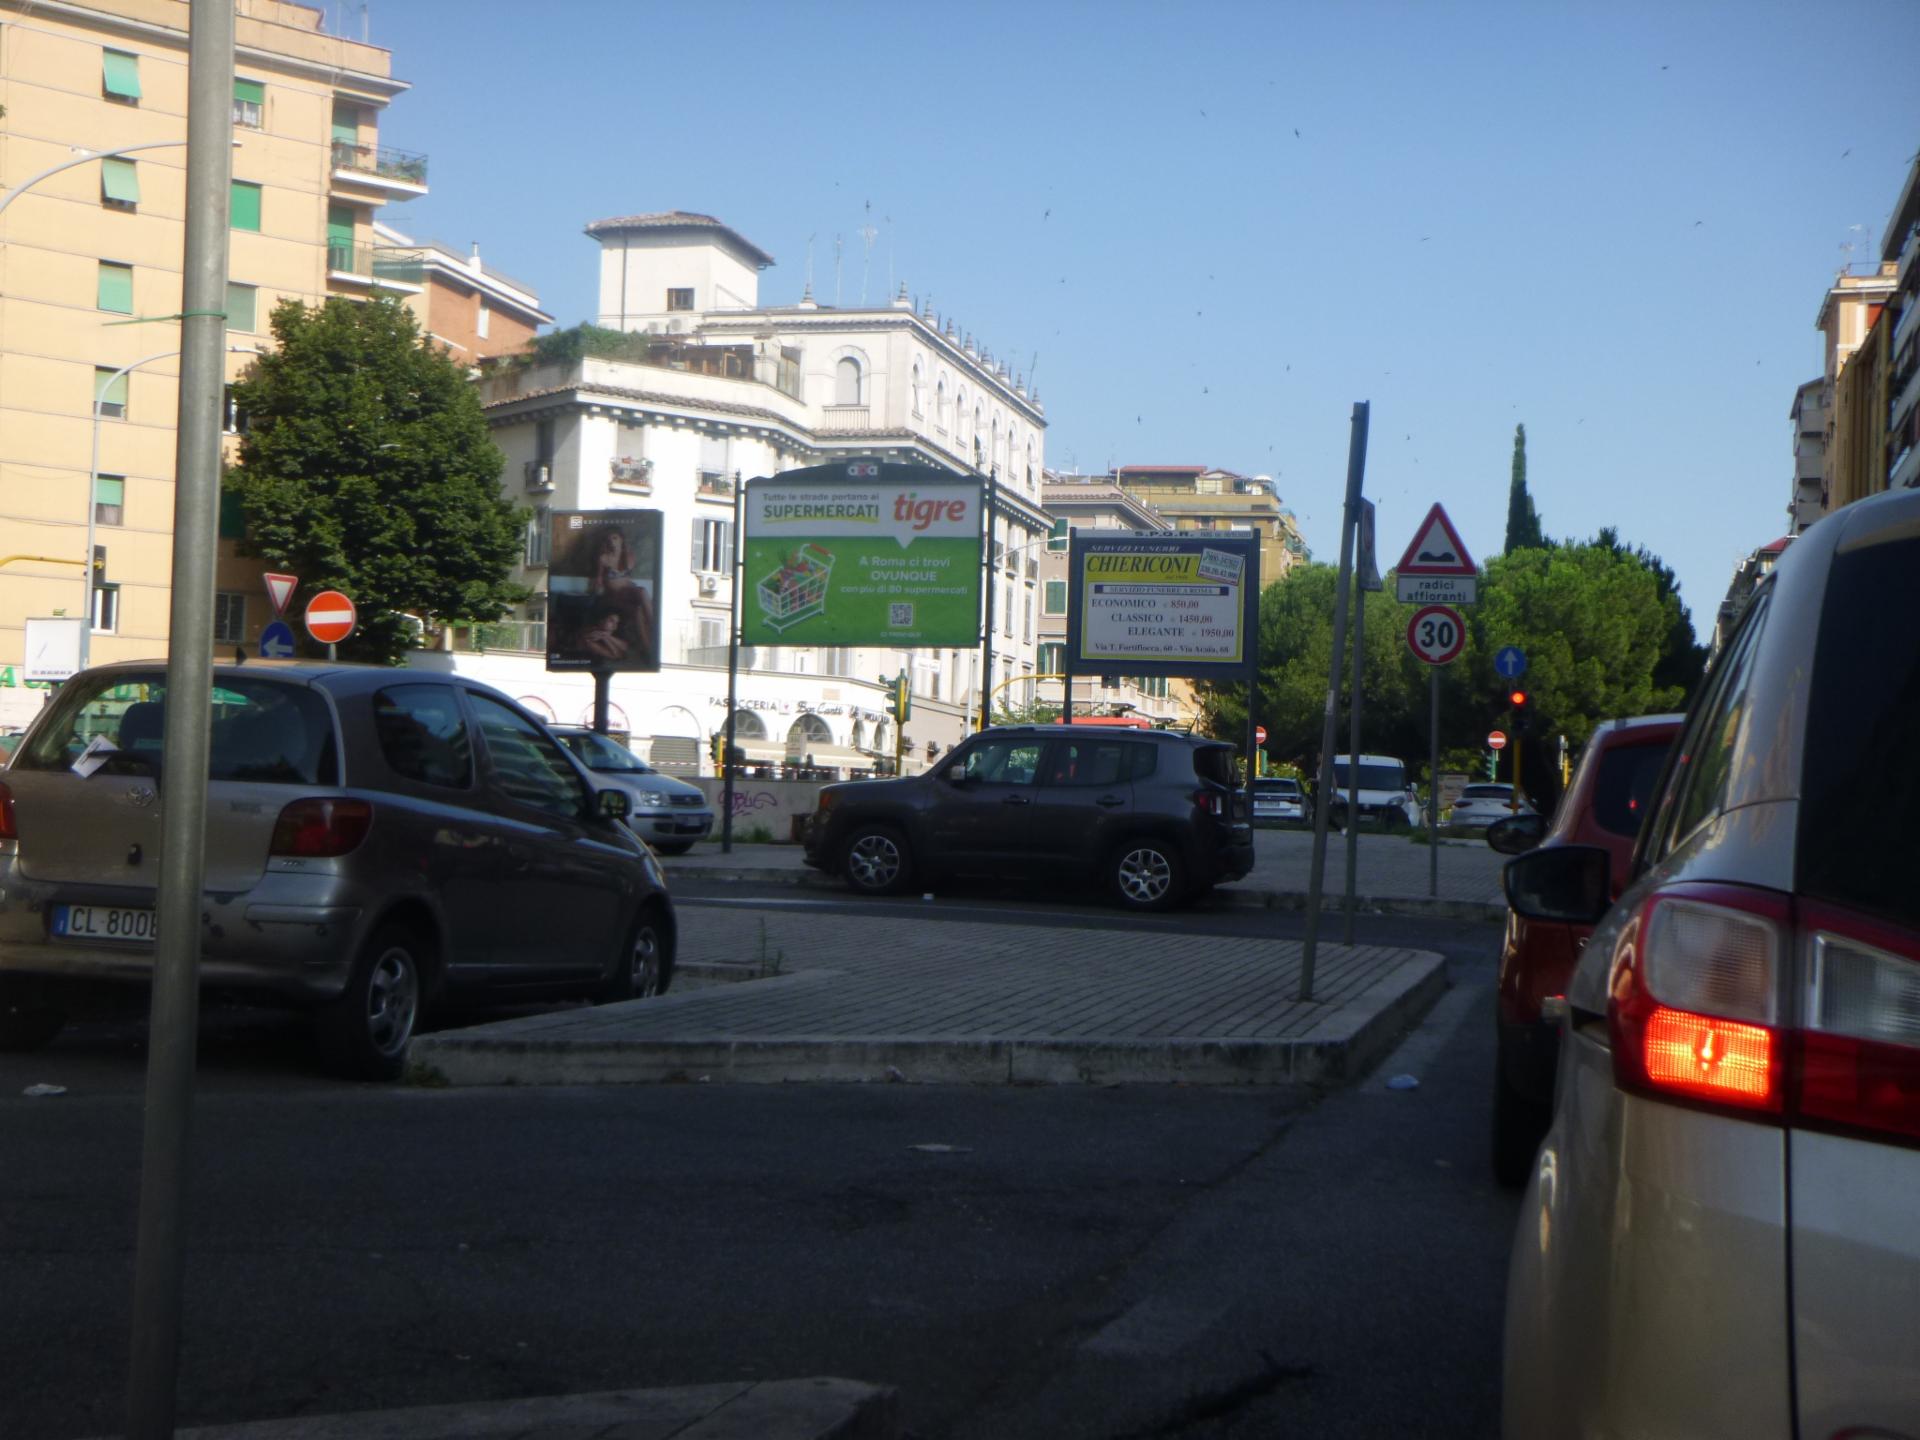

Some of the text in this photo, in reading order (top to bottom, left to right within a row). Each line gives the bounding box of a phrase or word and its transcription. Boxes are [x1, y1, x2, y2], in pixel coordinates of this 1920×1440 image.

[763, 493, 787, 501] Tutte
[789, 493, 797, 501] le
[800, 493, 829, 501] strade
[832, 494, 868, 503] portano
[763, 503, 880, 519] SUPERMERCATI
[893, 492, 967, 531] tigre
[859, 556, 951, 567] A Roma ci trovi
[1086, 555, 1191, 574] CHIERICONI
[871, 570, 937, 582] OVUNQUE
[1418, 580, 1455, 590] radici
[1406, 591, 1467, 601] affioranti
[1091, 599, 1157, 609] ECONOMICO
[1111, 613, 1164, 623] CLASSICO
[1127, 626, 1185, 637] ELEGANTE
[1420, 620, 1454, 648] 30
[708, 696, 778, 711] PASCCERIA
[71, 907, 97, 934] CL
